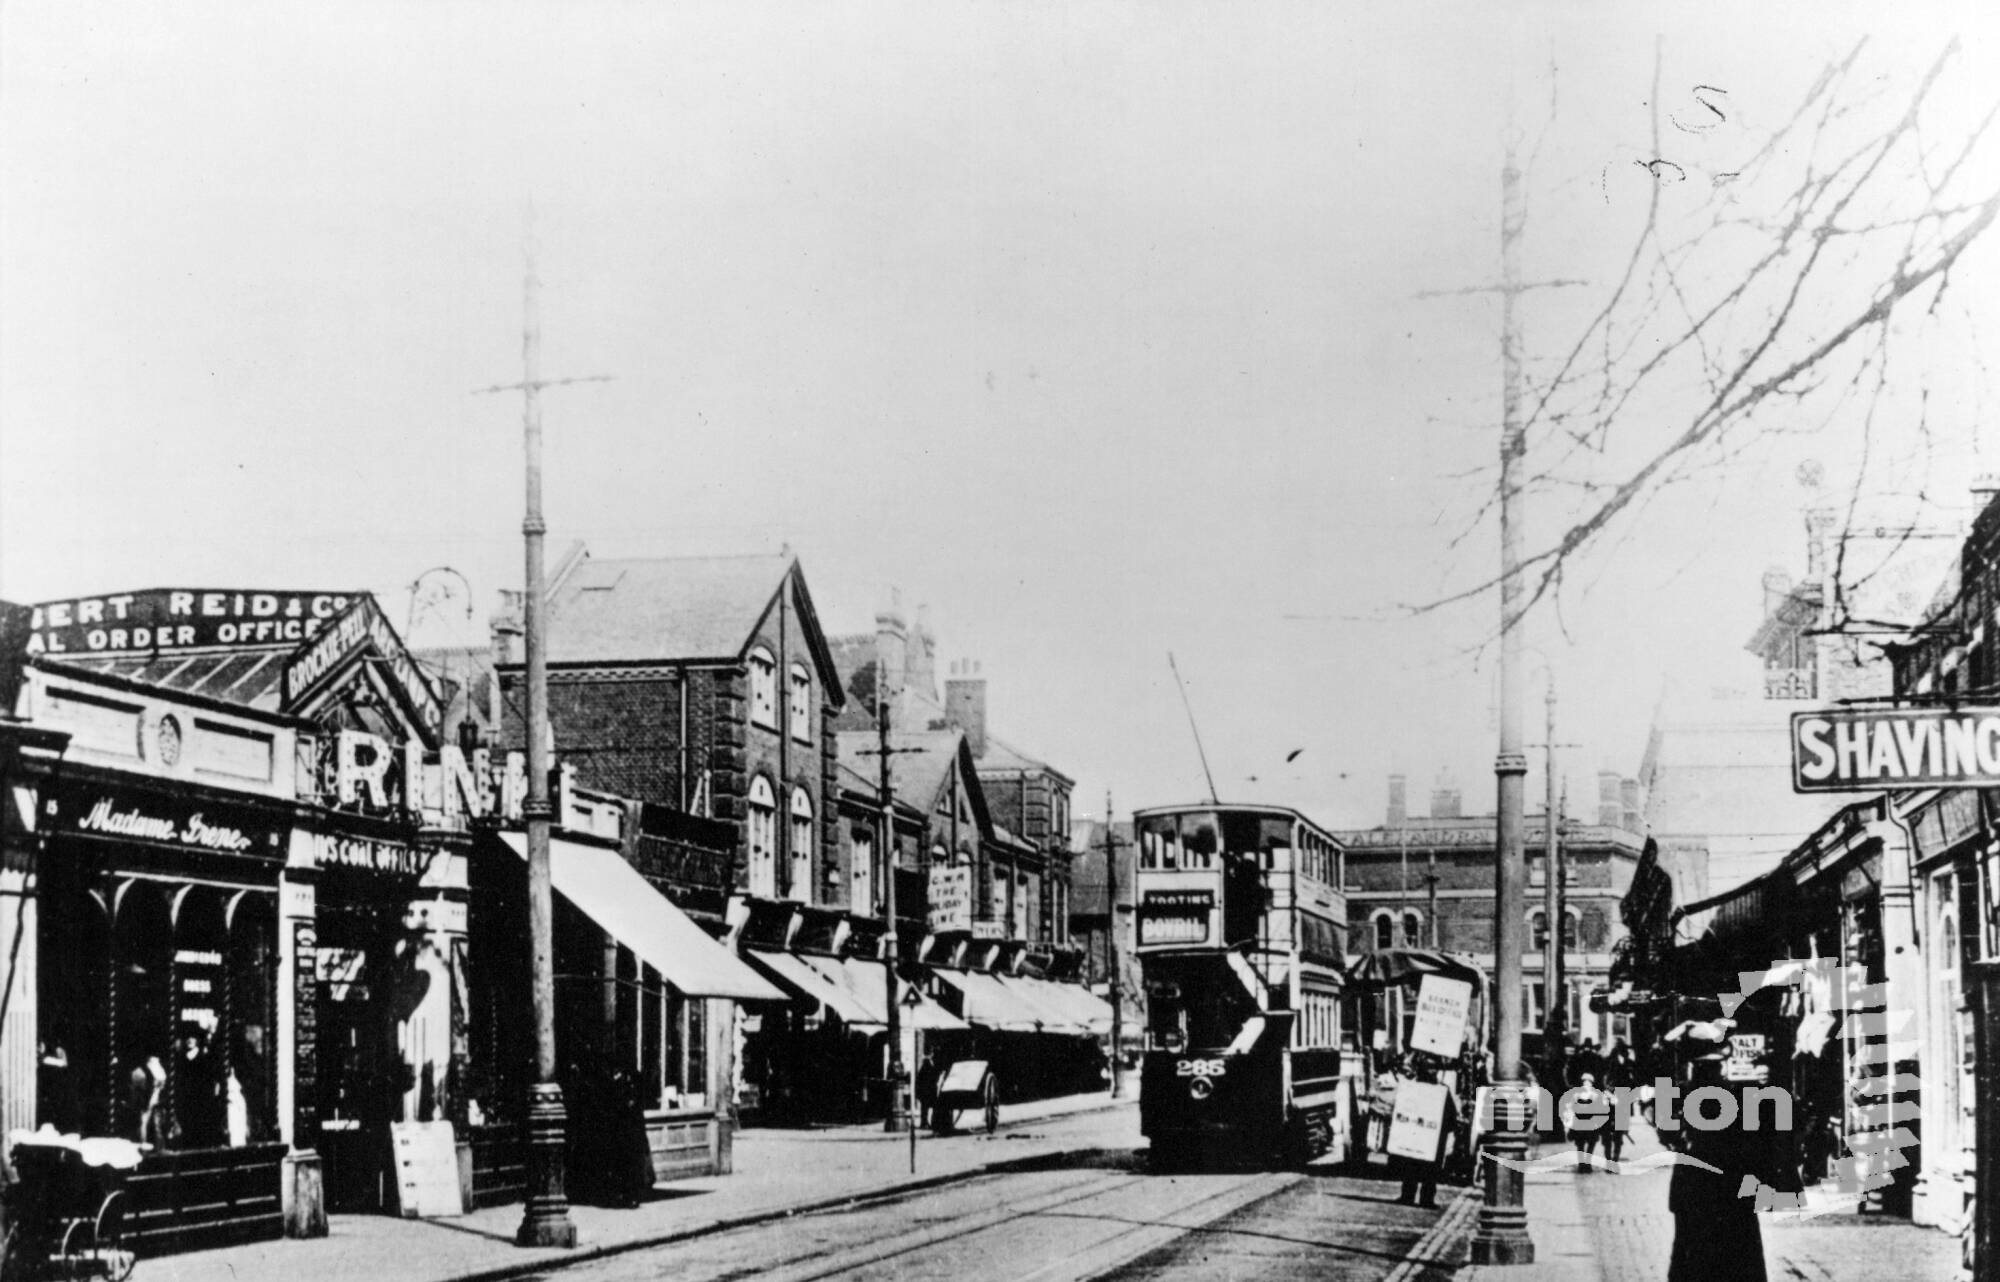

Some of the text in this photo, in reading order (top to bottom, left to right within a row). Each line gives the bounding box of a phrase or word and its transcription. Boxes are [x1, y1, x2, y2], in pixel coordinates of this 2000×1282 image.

[170, 592, 278, 616] REID
[87, 625, 196, 649] ORDER
[217, 619, 322, 643] OFFICE
[1800, 717, 2000, 780] SHAVING
[78, 798, 178, 840] Madame
